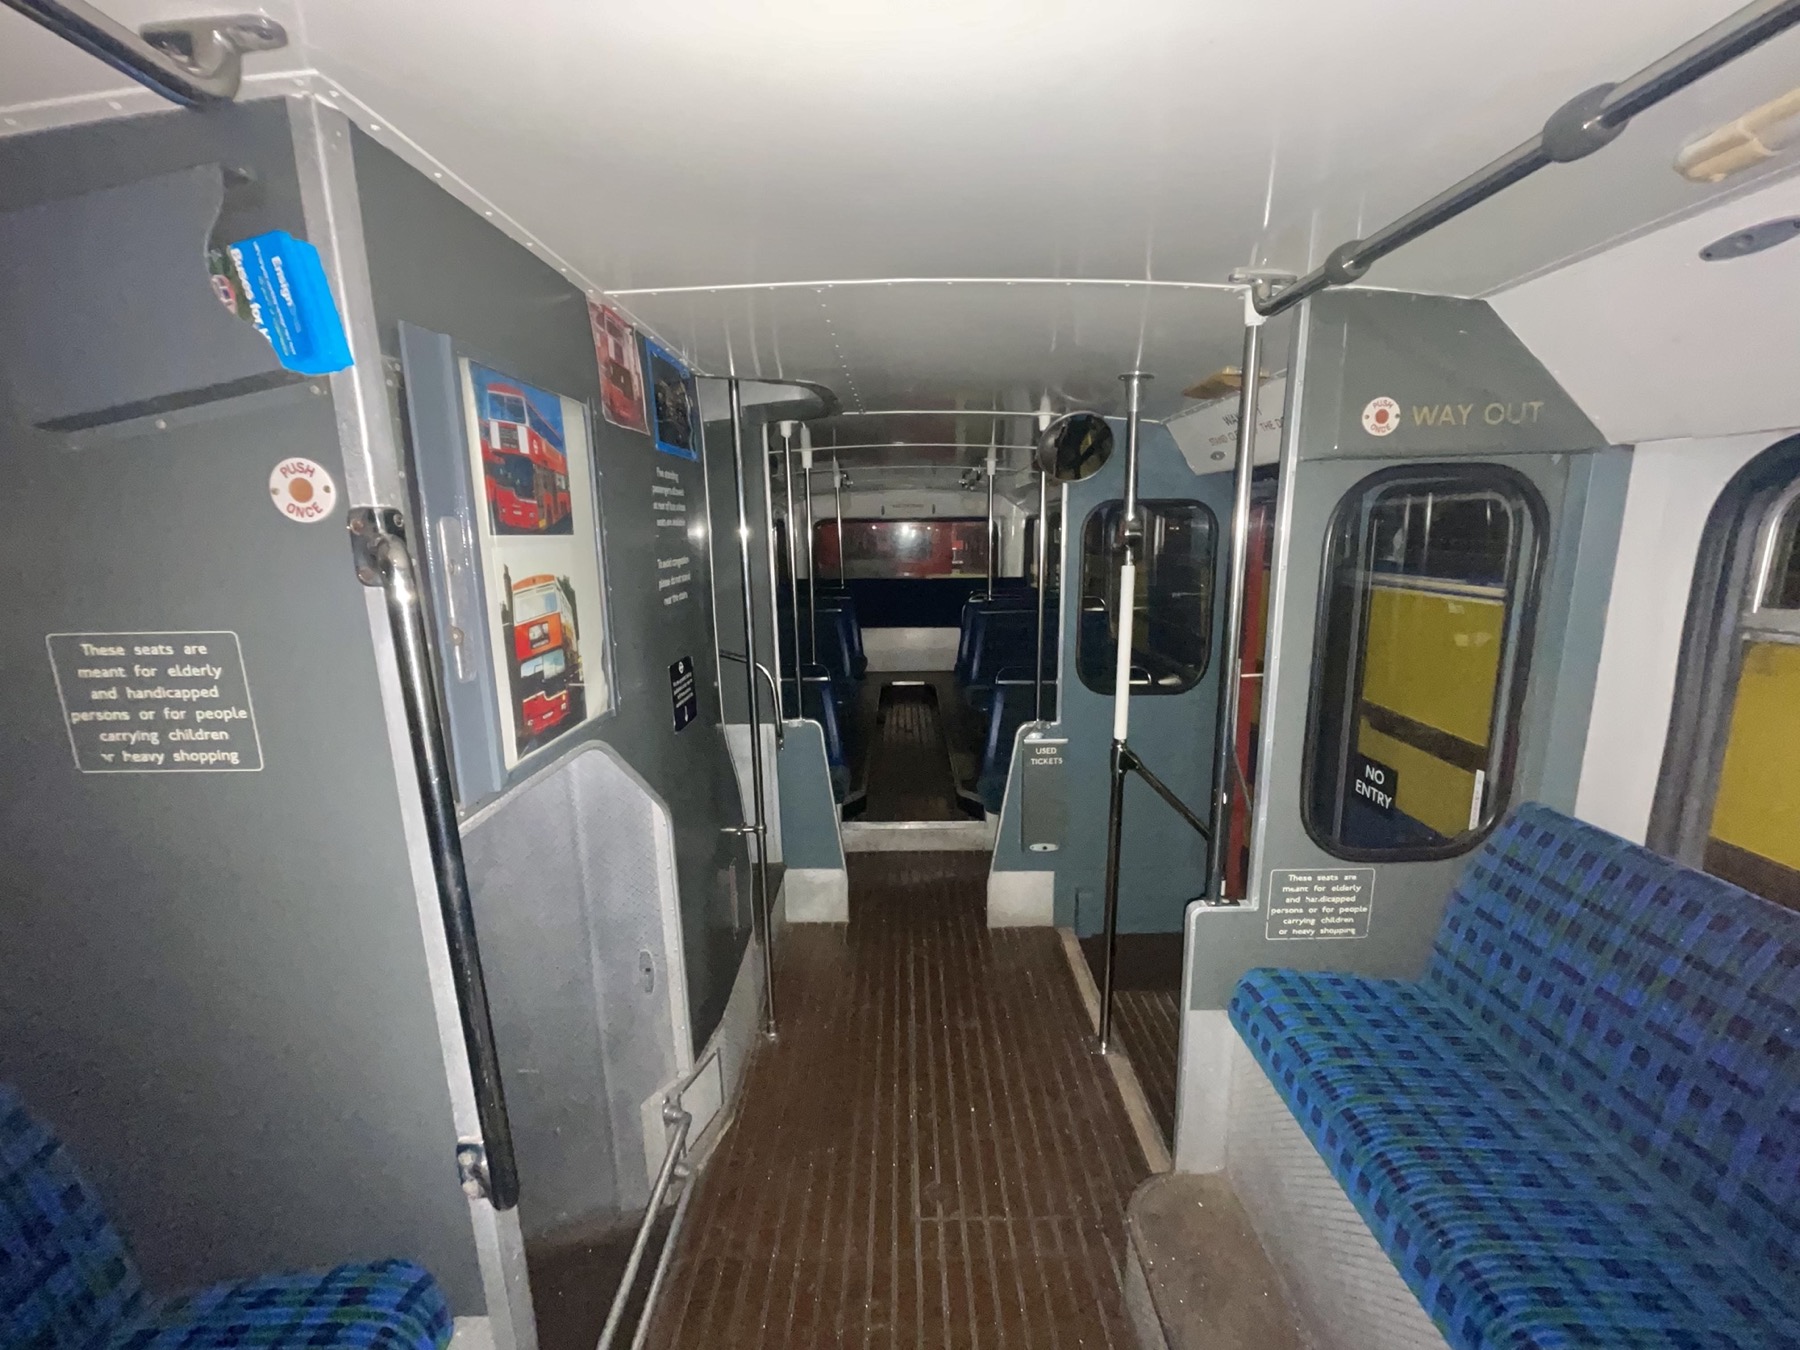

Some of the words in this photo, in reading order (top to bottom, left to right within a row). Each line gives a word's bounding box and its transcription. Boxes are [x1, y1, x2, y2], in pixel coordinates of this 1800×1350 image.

[1372, 399, 1393, 409] PUSH
[1412, 404, 1474, 426] WAY
[1484, 401, 1544, 425] OUT
[1370, 423, 1392, 433] ONCE
[280, 462, 315, 478] PUSH
[286, 501, 323, 518] ONCE
[80, 643, 125, 656] These
[133, 644, 174, 655] seats
[183, 645, 208, 655] are
[77, 667, 127, 678] meant
[133, 664, 158, 677] for
[167, 664, 222, 680] elderly
[91, 687, 117, 700] and
[125, 685, 220, 701] handicapped
[70, 710, 130, 724] persons
[138, 710, 156, 721] or
[163, 707, 187, 720] for
[195, 706, 248, 723] people
[100, 731, 160, 745] carrying
[168, 728, 230, 742] children
[172, 749, 240, 765] shopping
[1035, 747, 1057, 755] USED
[1030, 757, 1063, 765] TICKETS
[1365, 764, 1385, 785] NO
[1355, 779, 1392, 809] ENTRY
[1288, 874, 1312, 882] These
[1313, 884, 1326, 892] for
[1331, 884, 1361, 893] elderly
[1285, 896, 1300, 904] and
[1270, 907, 1304, 916] persons
[1339, 905, 1368, 914] people
[1282, 918, 1316, 926] carrying
[1320, 916, 1354, 924] children
[1320, 927, 1356, 936] shopping
